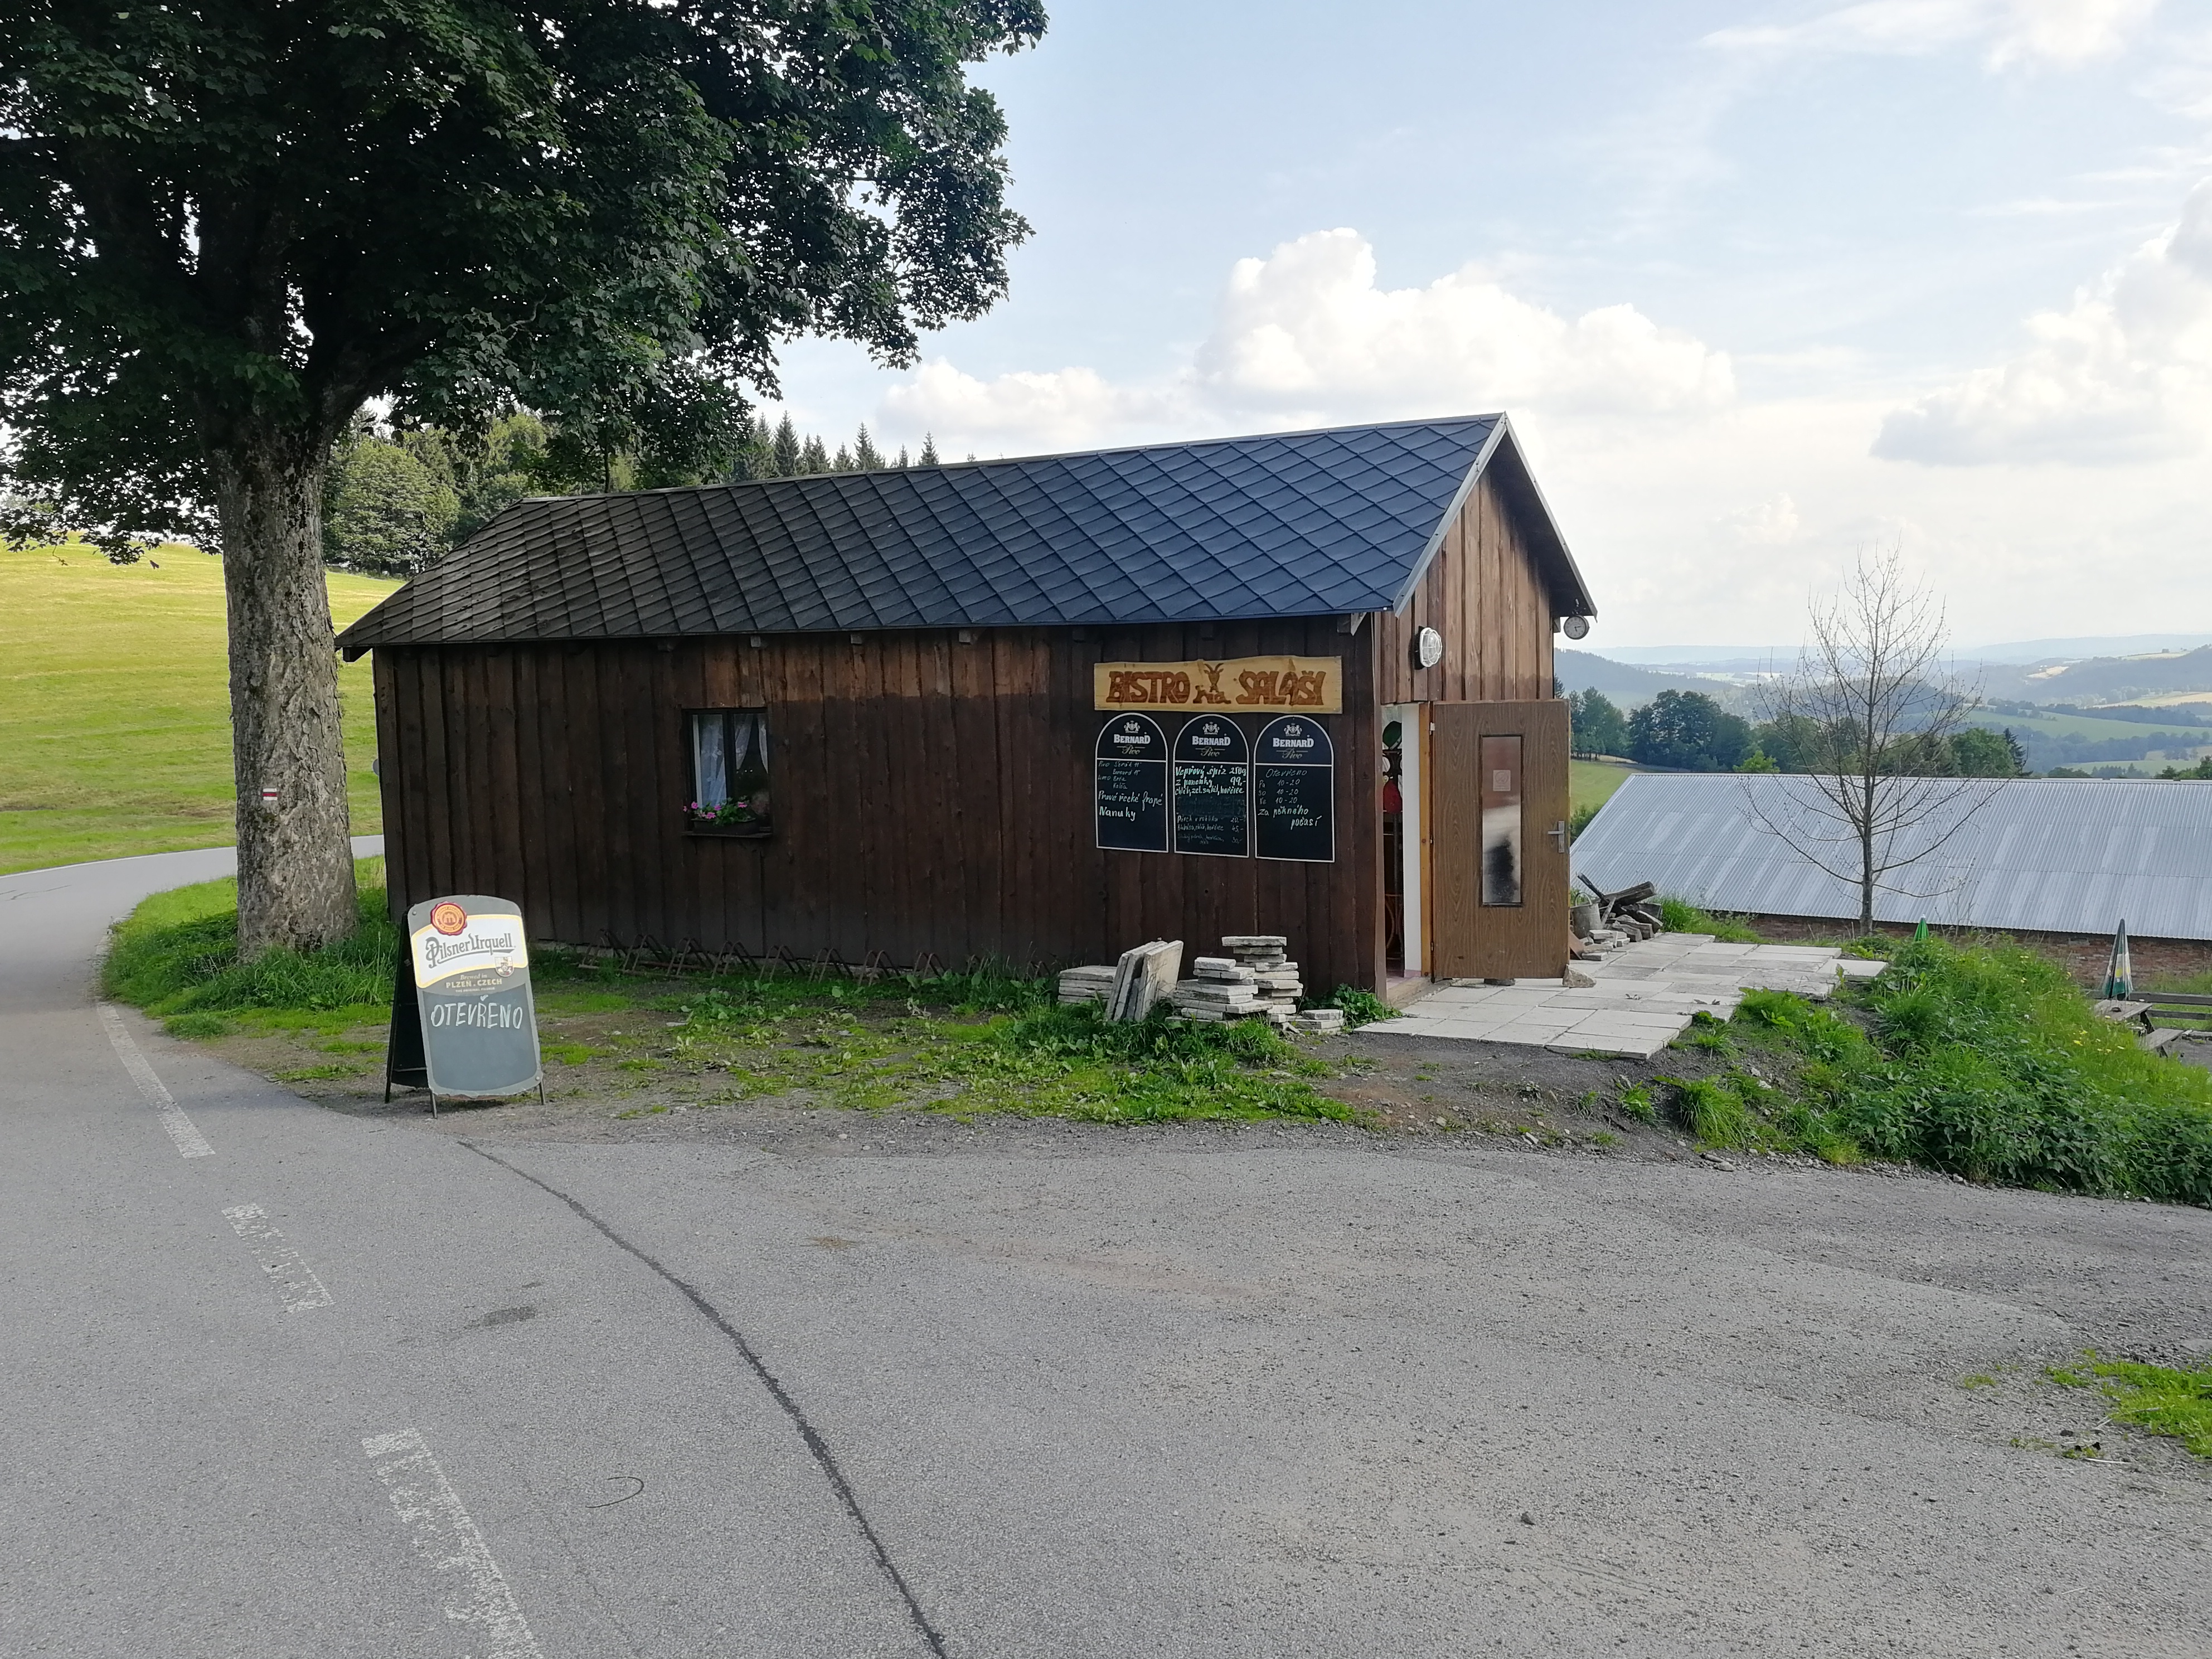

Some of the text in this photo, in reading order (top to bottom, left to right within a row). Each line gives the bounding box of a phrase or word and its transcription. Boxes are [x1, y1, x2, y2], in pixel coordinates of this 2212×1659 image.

[1105, 671, 1191, 704] BISTRO
[1236, 670, 1326, 706] SALAŠI
[1114, 732, 1151, 744] BERNARD
[1192, 734, 1231, 746] BERNARD
[1273, 735, 1314, 748] BERNARD
[1122, 744, 1141, 755] Pivo
[1201, 746, 1220, 757] Pivo
[1282, 748, 1303, 759] Pivo
[1265, 768, 1308, 778] Otevřeno
[1098, 790, 1118, 802] Pravé
[1099, 806, 1136, 821] Nanuky
[425, 933, 513, 969] Pilsner Urquell
[430, 995, 523, 1030] OTEVŘENO
